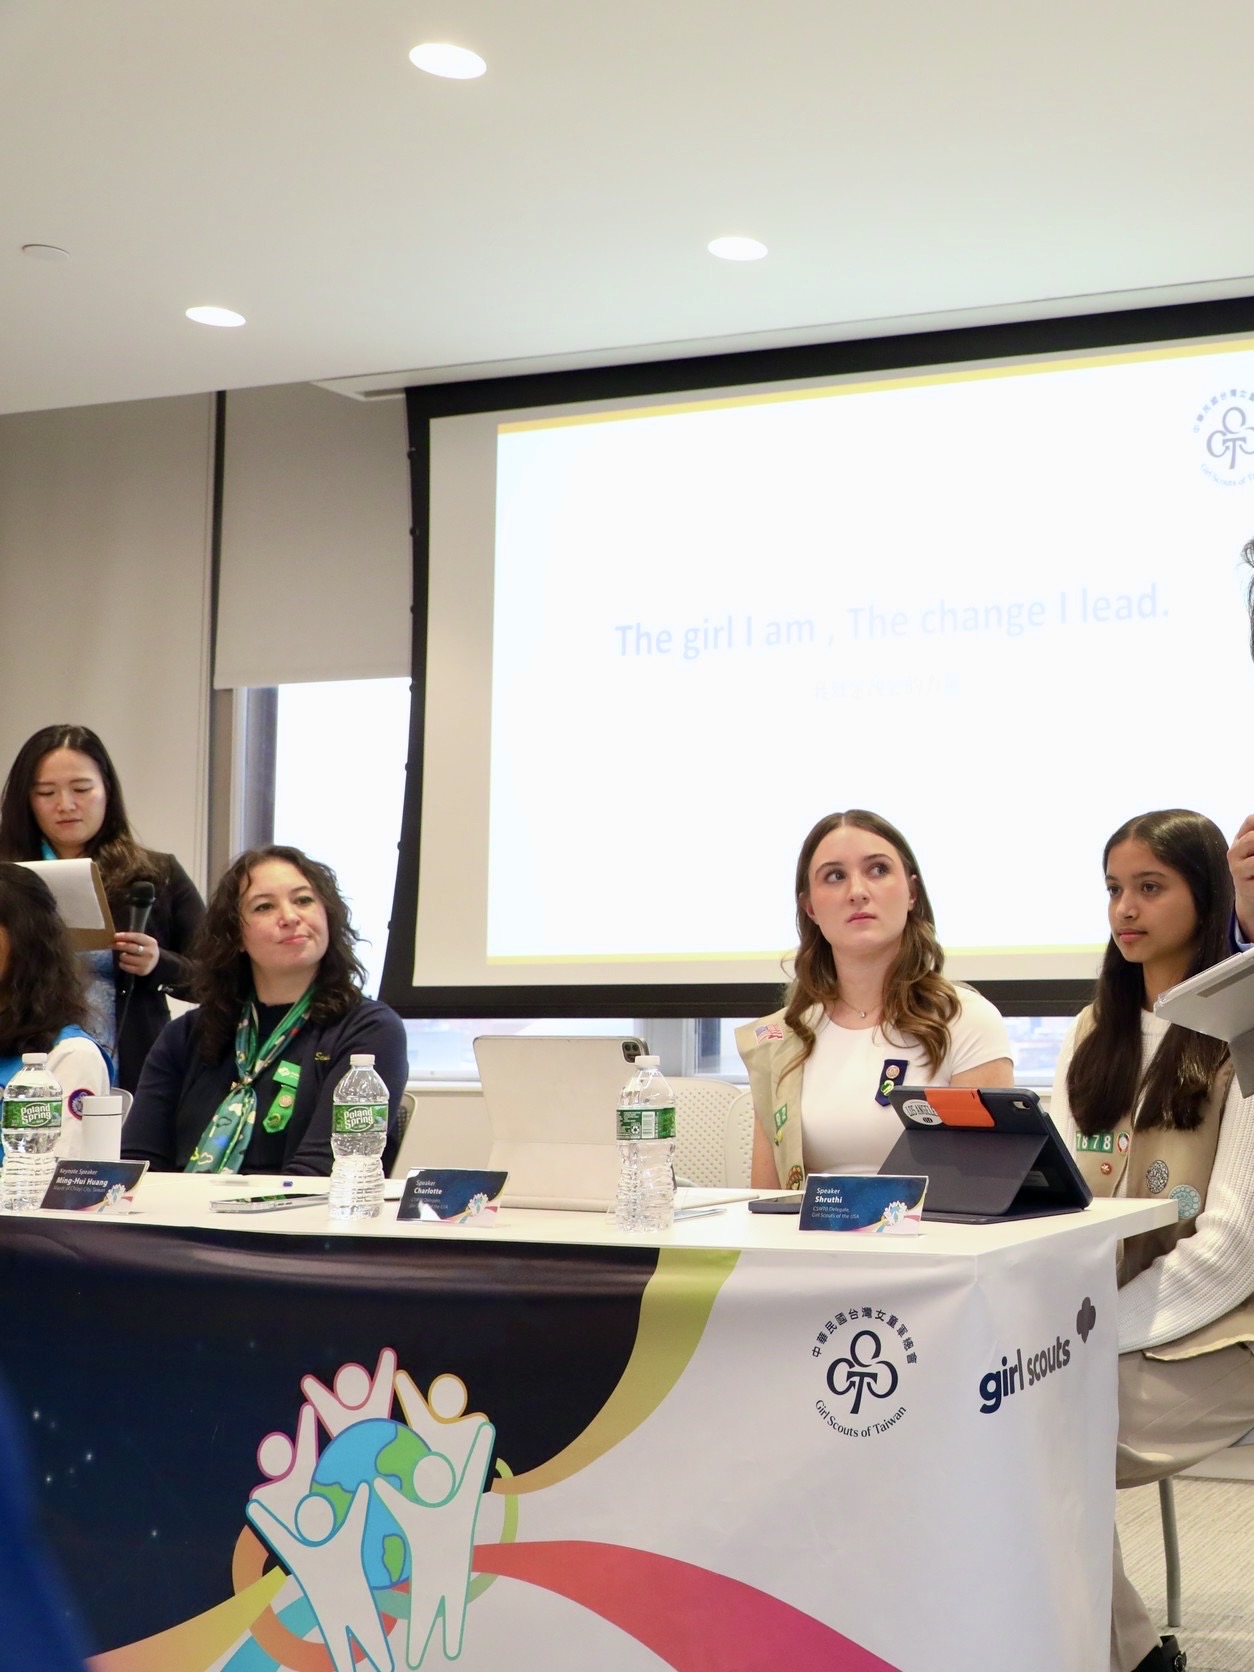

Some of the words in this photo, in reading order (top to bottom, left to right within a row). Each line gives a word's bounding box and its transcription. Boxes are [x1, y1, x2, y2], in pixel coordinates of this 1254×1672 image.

[616, 624, 673, 658] The
[682, 614, 734, 661] girl
[765, 617, 816, 646] am
[848, 607, 909, 639] The
[920, 599, 1047, 637] change
[1080, 582, 1170, 623] lead.
[21, 1102, 50, 1116] Poland
[344, 1107, 373, 1121] Poland
[22, 1110, 51, 1124] Spring
[345, 1115, 373, 1129] Spring
[56, 1177, 86, 1186] Ming-Hui
[87, 1178, 108, 1187] Huang
[979, 1348, 1024, 1414] girl
[1027, 1336, 1070, 1386] scouts
[816, 1400, 830, 1420] Girl
[827, 1416, 858, 1437] Scouts
[861, 1426, 871, 1437] of
[873, 1406, 906, 1434] Taiwan
